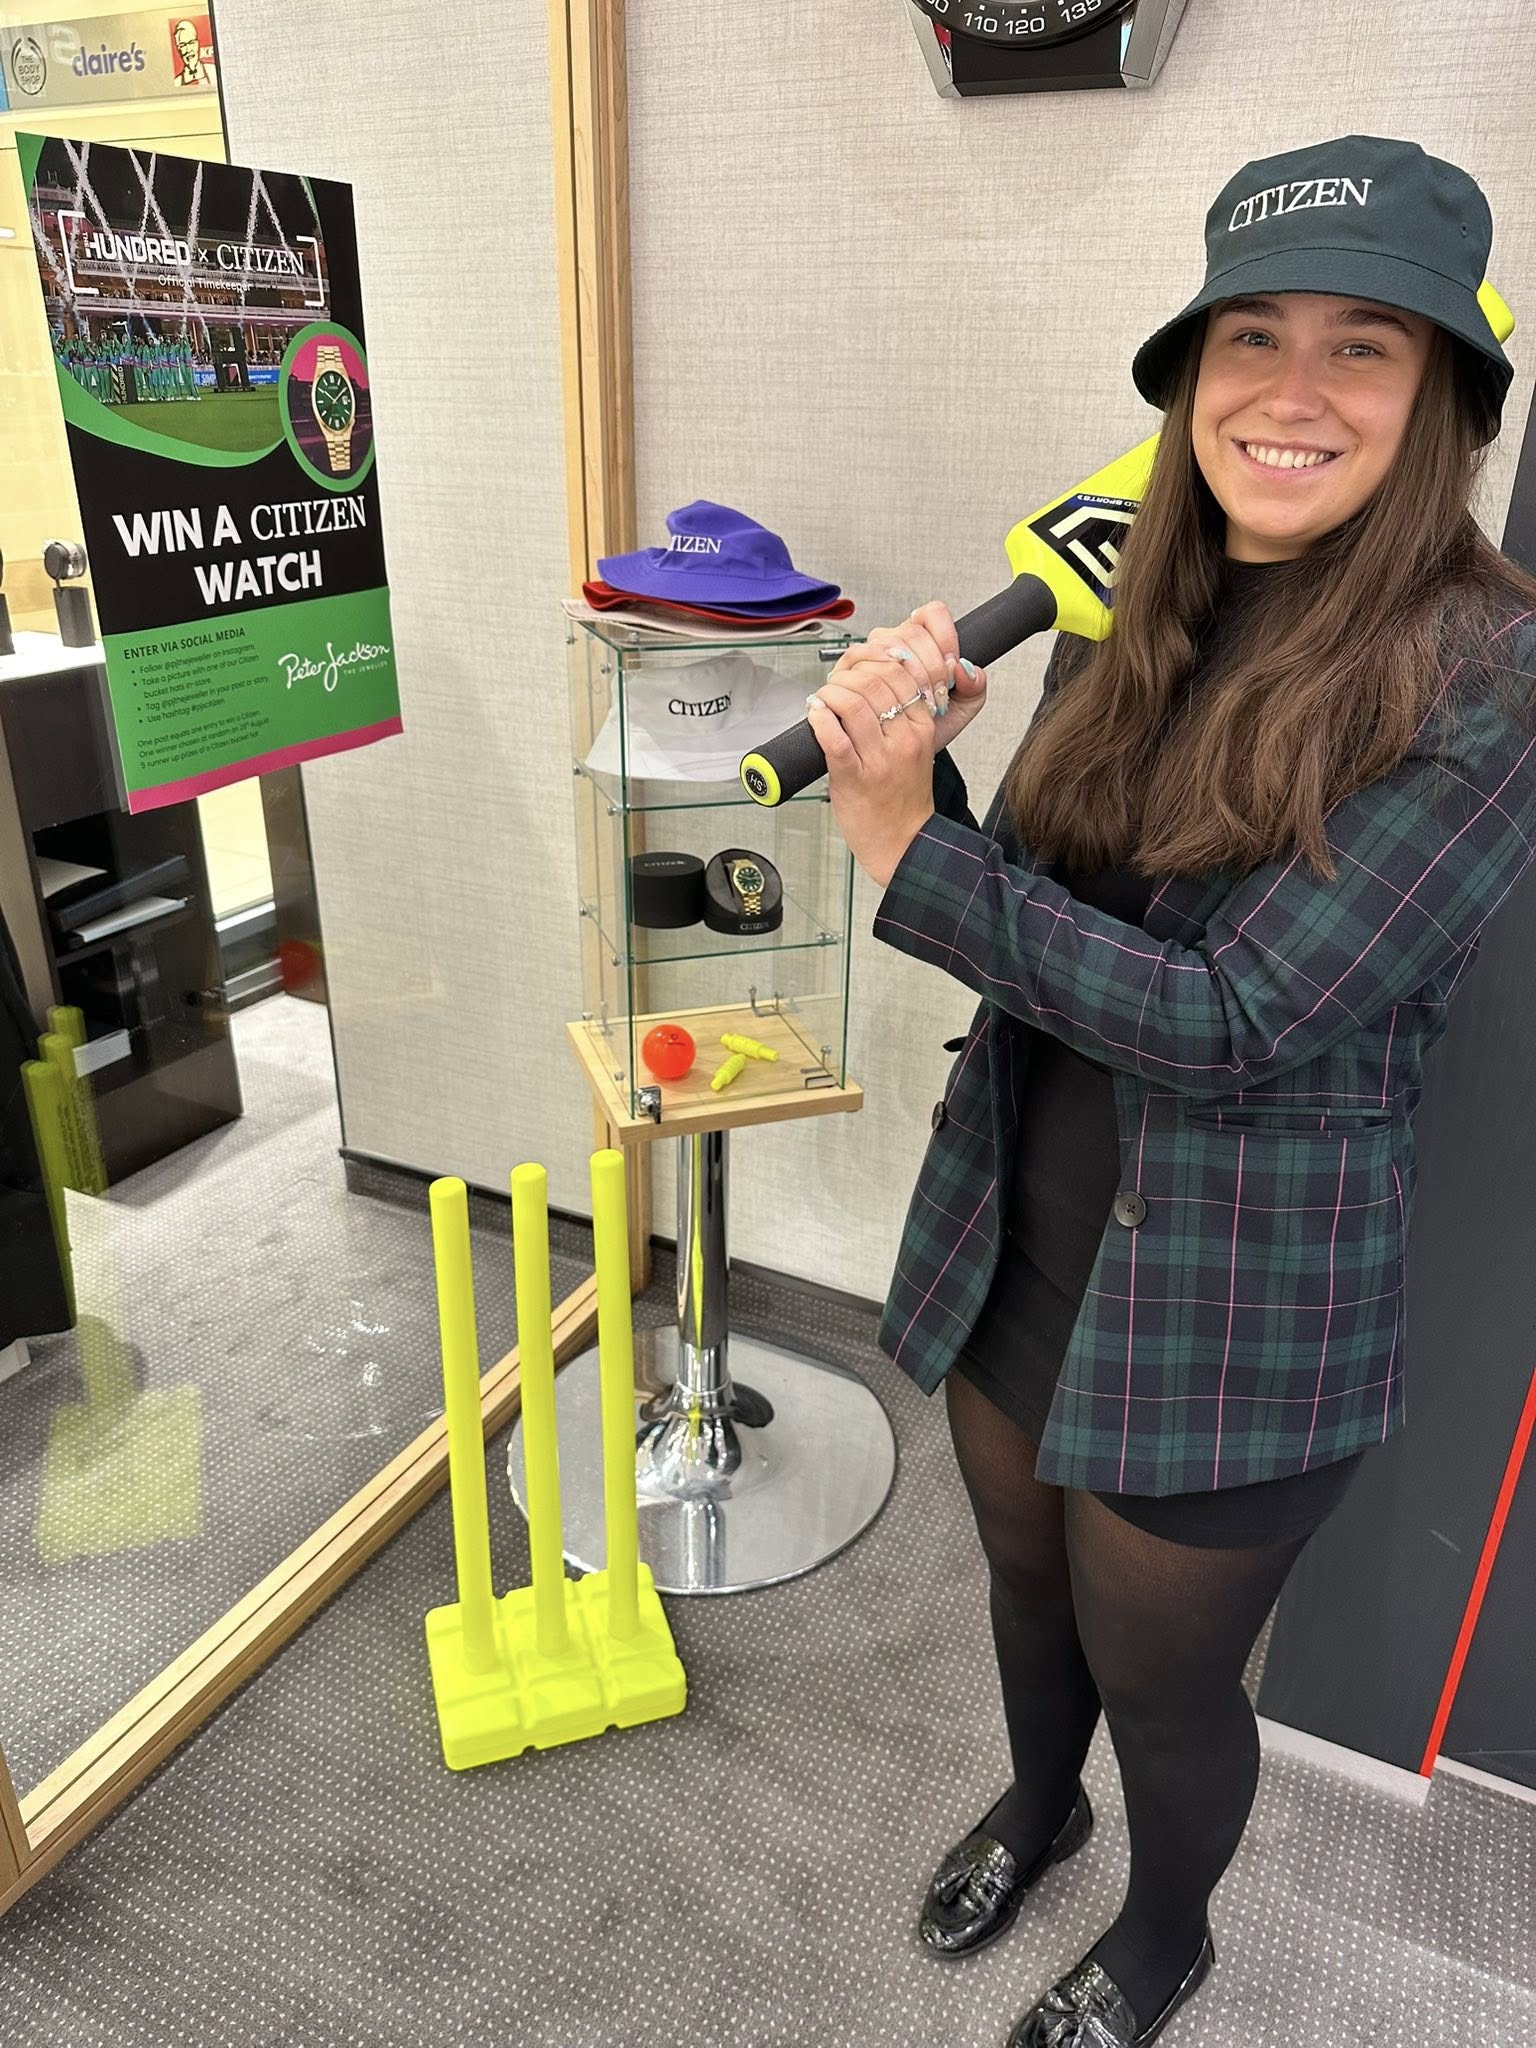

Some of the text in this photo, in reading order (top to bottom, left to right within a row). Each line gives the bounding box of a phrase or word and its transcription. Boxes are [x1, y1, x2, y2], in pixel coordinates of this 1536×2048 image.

[1060, 0, 1101, 23] 135
[964, 12, 998, 33] 110
[1004, 17, 1045, 35] 120
[18, 64, 40, 75] BODY
[21, 55, 34, 63] THE
[72, 42, 145, 77] claire's
[20, 75, 41, 86] SHOP
[1228, 177, 1373, 232] CITIZEN
[85, 231, 191, 266] HUNDRED
[216, 243, 305, 275] CITIZEN
[158, 274, 252, 292] Official Timekeeper
[111, 495, 367, 558] WIN A CITIZEN
[193, 549, 323, 606] WATCH
[123, 627, 246, 660] ENTER VIA SOCIAL MEDIA
[140, 662, 162, 673] Follow
[142, 675, 159, 685] Take
[167, 669, 191, 682] picture
[192, 666, 205, 674] with
[238, 653, 259, 664] Citizen
[278, 642, 390, 692] Peter Jackson
[144, 686, 168, 698] bucket
[169, 682, 184, 692] hats
[146, 701, 160, 712] Tag
[217, 685, 229, 694] your
[231, 681, 245, 690] post
[254, 675, 268, 685] story
[147, 713, 161, 723] Use
[162, 706, 190, 721] hashtag
[138, 737, 152, 747] One
[154, 735, 169, 744] post
[170, 729, 190, 740] equals
[191, 726, 202, 734] one
[242, 709, 259, 719] Citizen
[139, 748, 154, 758] One
[156, 743, 177, 754] winner
[178, 737, 200, 748] chosen
[147, 756, 169, 768] runner
[171, 754, 180, 762] up
[181, 749, 197, 759] prizes
[750, 774, 763, 791] HS
